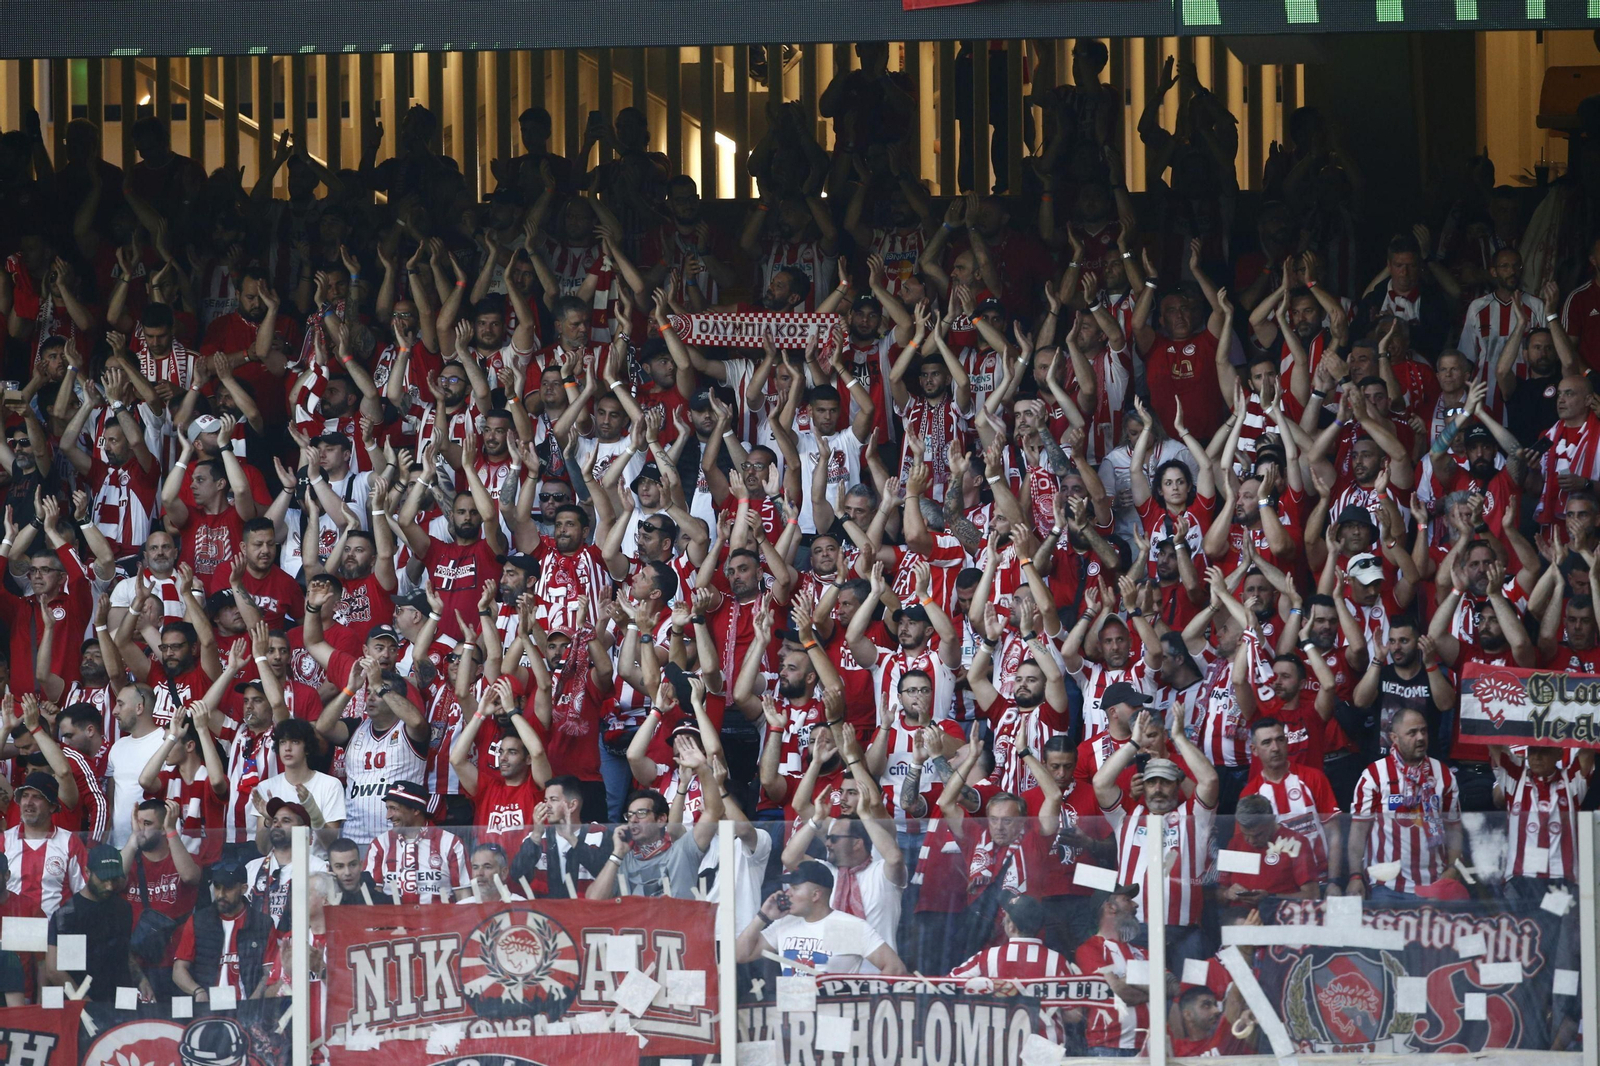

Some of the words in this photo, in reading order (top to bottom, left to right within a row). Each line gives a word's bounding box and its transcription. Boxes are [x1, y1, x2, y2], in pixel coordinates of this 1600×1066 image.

[699, 320, 809, 338] ΟΛΥΜΠΙΑΚΟΣ
[364, 752, 386, 770] 10
[1026, 982, 1110, 1000] CLUB
